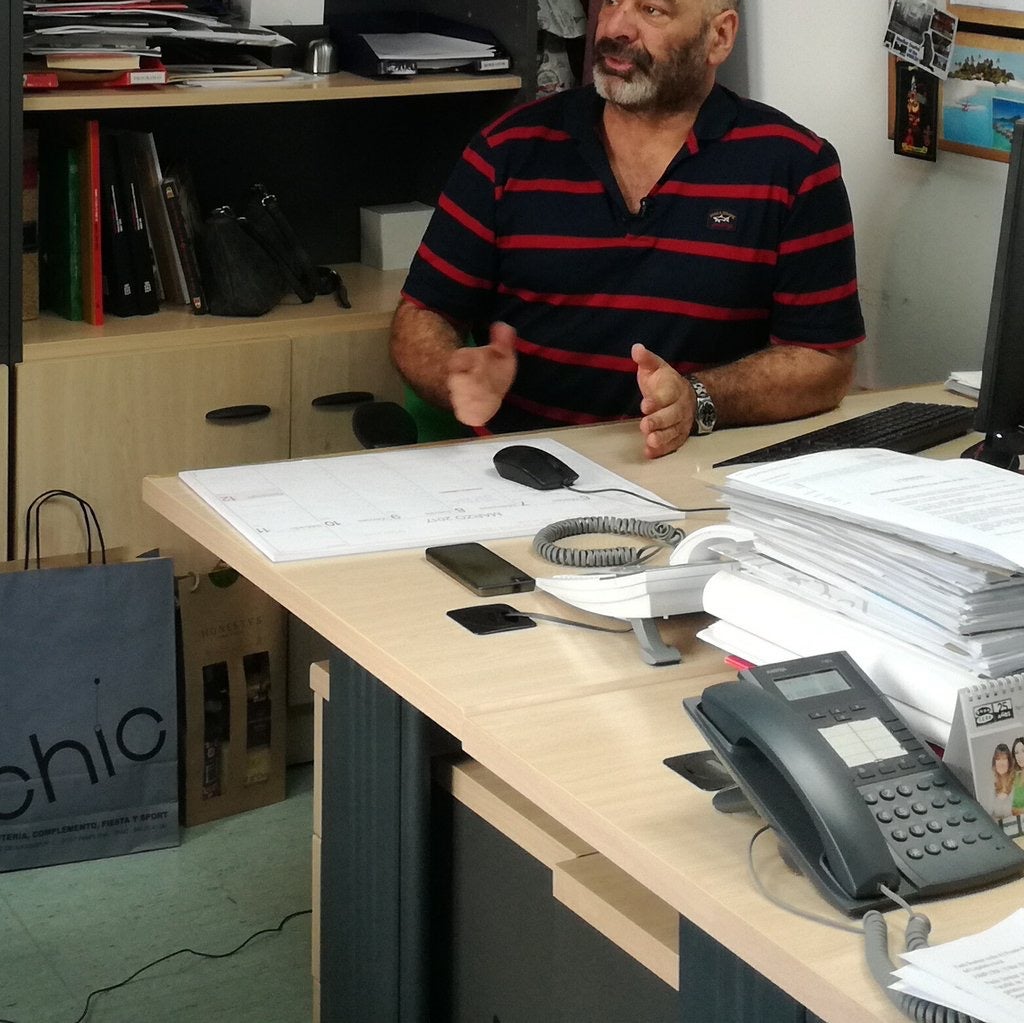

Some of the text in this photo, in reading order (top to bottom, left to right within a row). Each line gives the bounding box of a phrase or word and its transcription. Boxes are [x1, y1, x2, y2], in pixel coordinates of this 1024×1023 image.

[426, 516, 452, 524] 2017
[997, 701, 1009, 713] 25
[102, 816, 130, 829] FIESTA
[140, 811, 169, 822] SPORT
